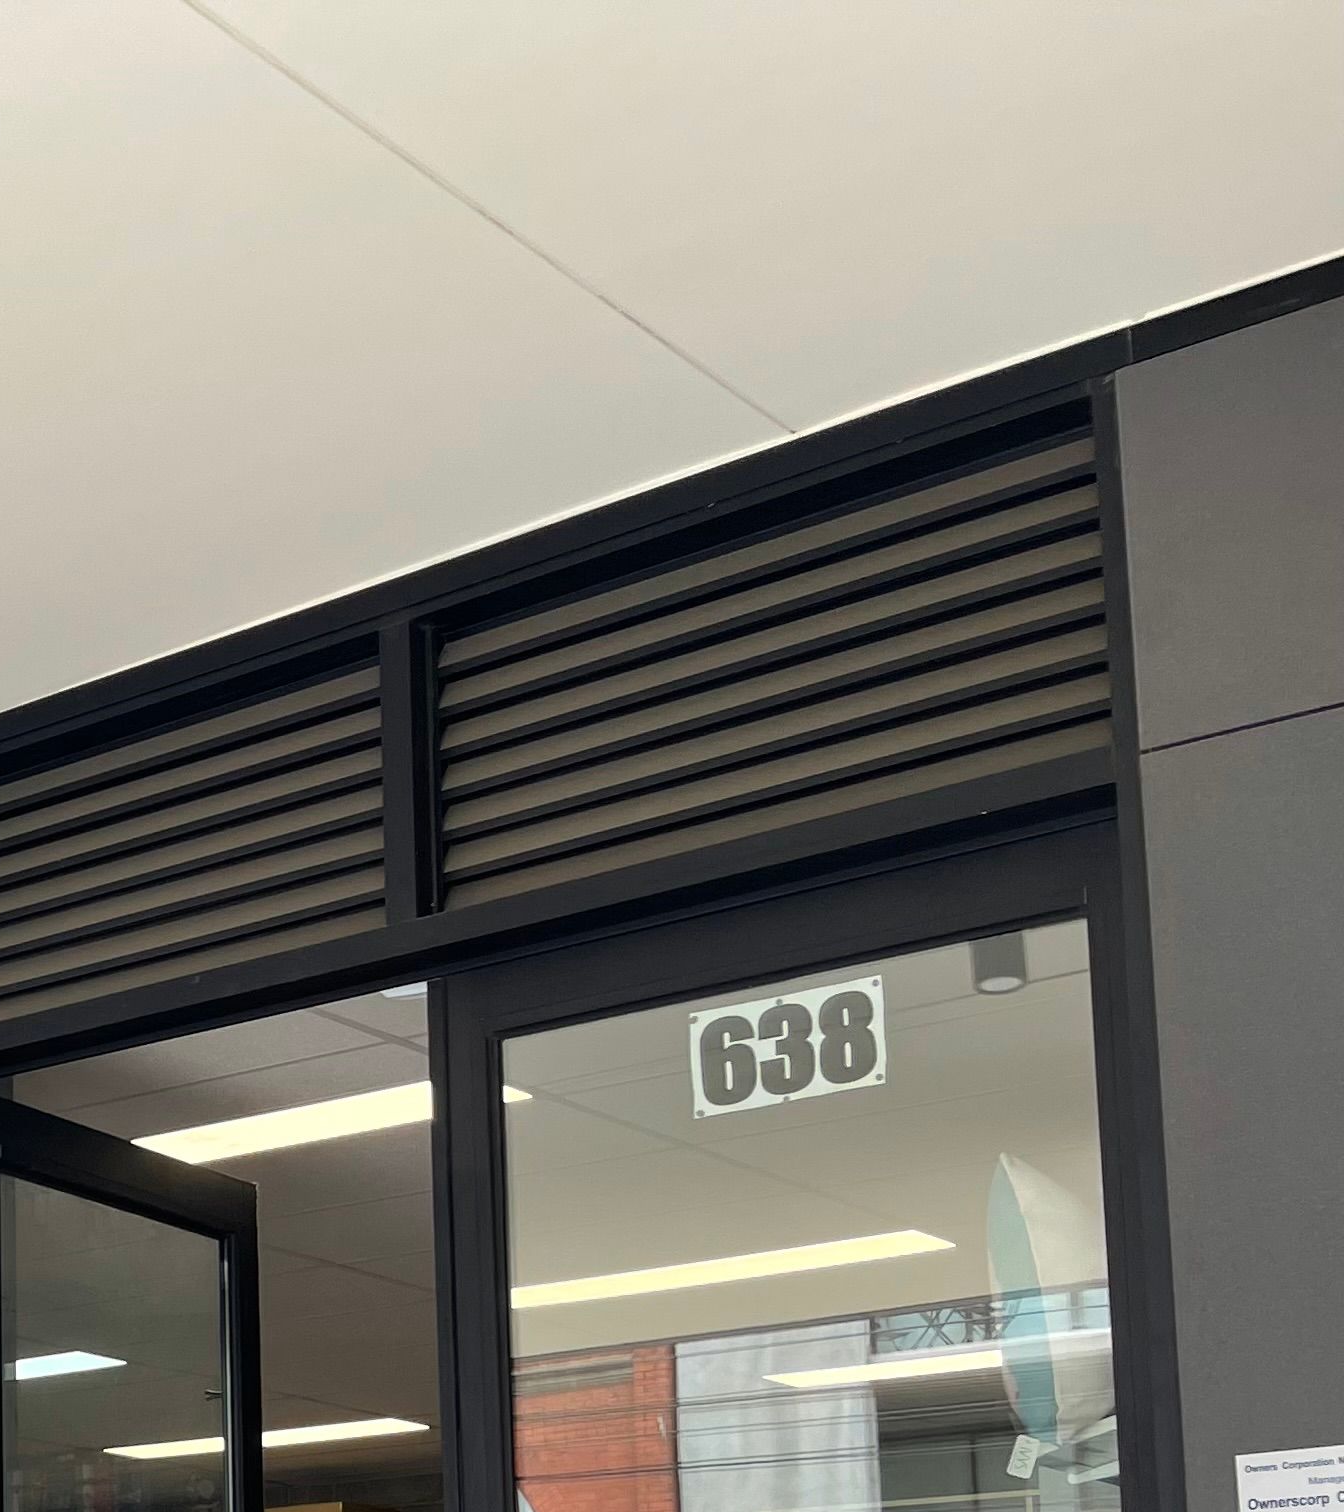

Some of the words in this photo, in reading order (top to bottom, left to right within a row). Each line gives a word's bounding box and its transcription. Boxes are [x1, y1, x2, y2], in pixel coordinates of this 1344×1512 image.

[699, 990, 878, 1106] 638
[1245, 1463, 1278, 1473] Owners
[1282, 1457, 1335, 1470] Corporation
[1248, 1494, 1330, 1511] Ownerscorp
